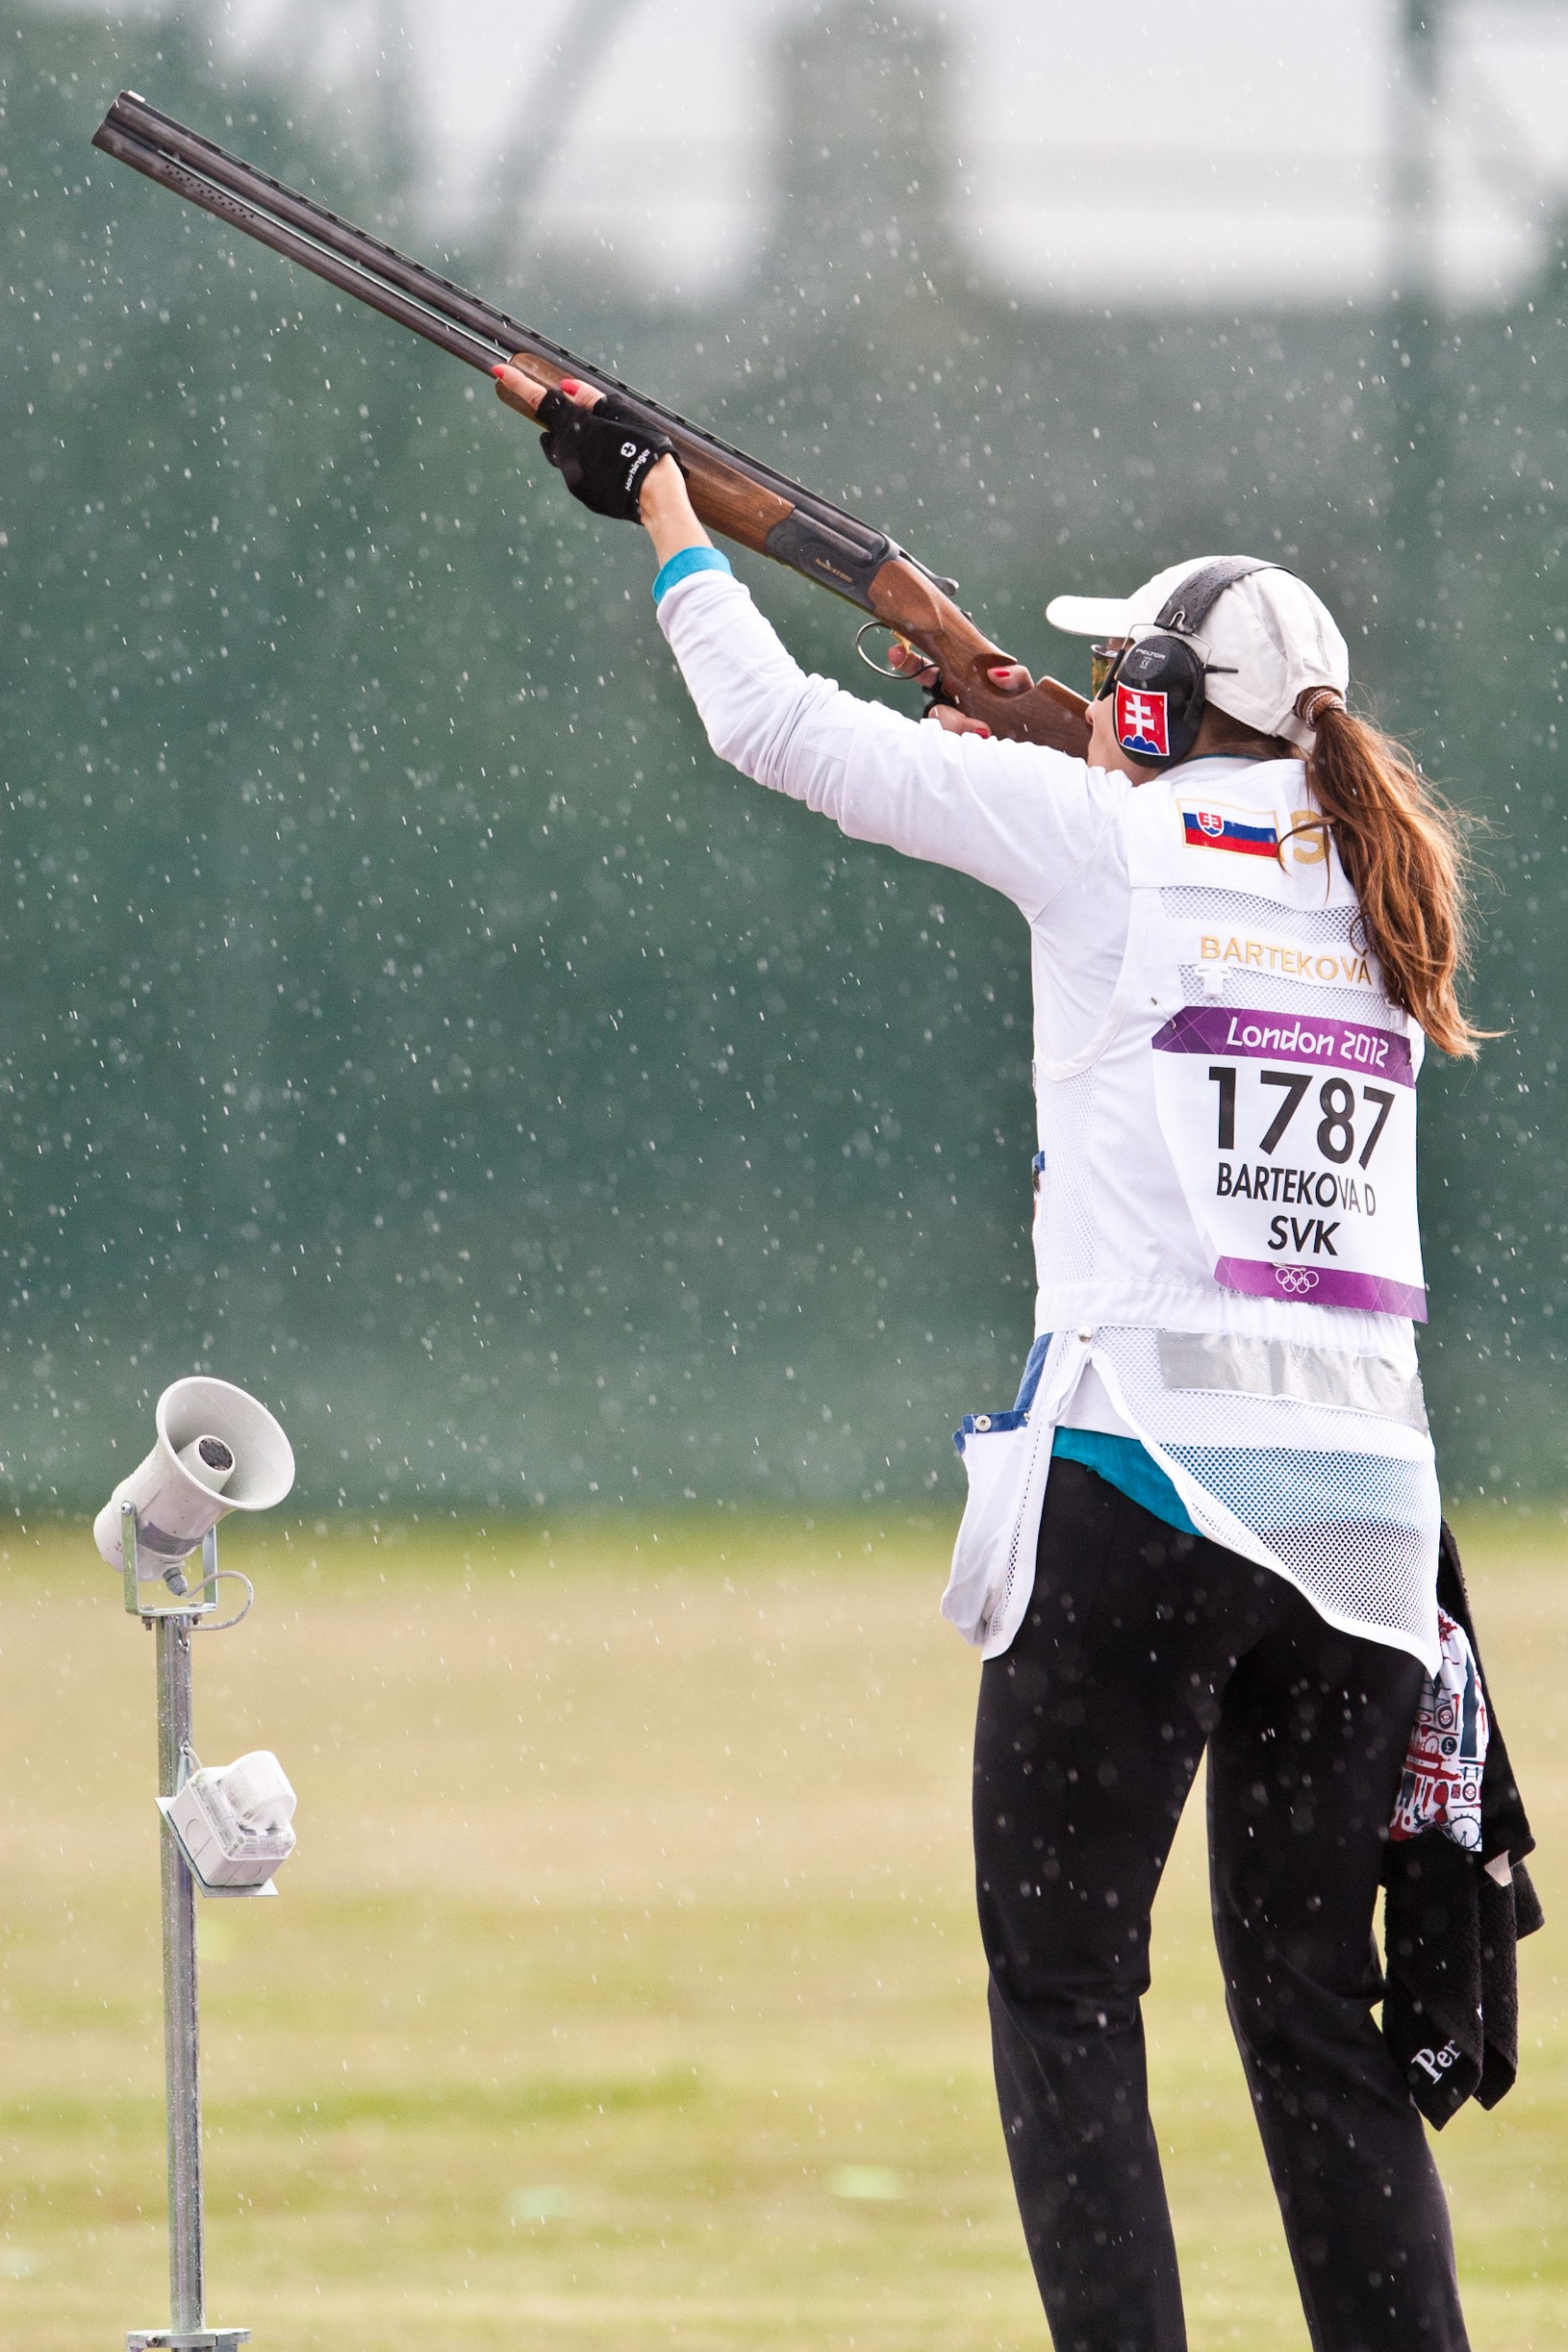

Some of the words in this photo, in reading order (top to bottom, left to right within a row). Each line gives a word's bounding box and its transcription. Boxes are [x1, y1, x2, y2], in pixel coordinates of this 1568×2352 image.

[1135, 648, 1166, 659] PELTOR
[1227, 1016, 1335, 1057] London
[1339, 1029, 1390, 1069] 2012
[1207, 1065, 1397, 1171] 1787
[1216, 1161, 1361, 1213] BARTEKOVA
[1364, 1182, 1377, 1217] D
[1267, 1214, 1342, 1256] SVK
[1410, 2038, 1462, 2085] Per
